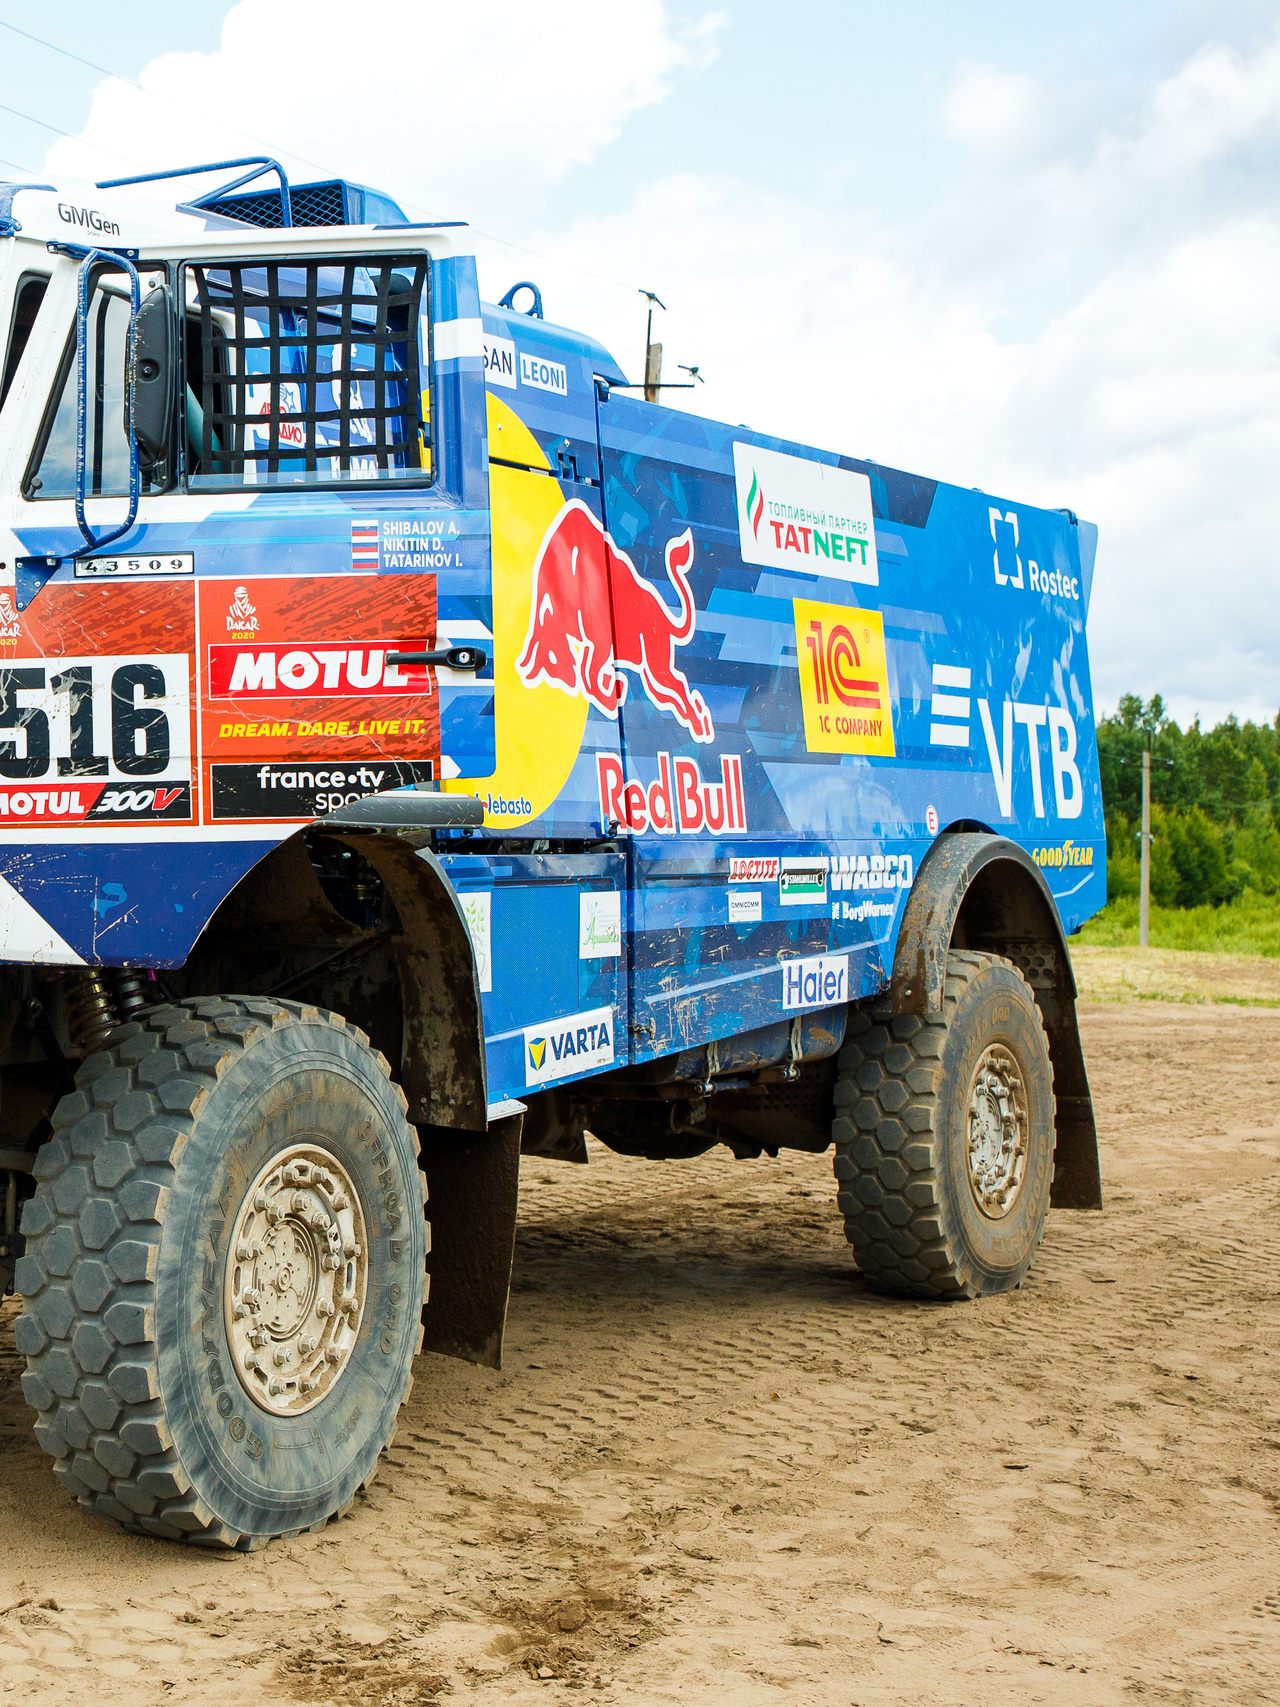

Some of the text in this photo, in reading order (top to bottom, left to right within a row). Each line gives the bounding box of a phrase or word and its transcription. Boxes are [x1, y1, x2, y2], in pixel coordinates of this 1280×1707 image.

[58, 203, 120, 236] GMGen
[522, 359, 564, 389] LEONI
[383, 521, 460, 535] SHIBALOV A.
[768, 501, 867, 535] ТОПЛИВНЫЙ ПАРТНЕР
[383, 538, 444, 552] NIKITIN D.
[770, 520, 868, 565] TATNEFT
[383, 554, 463, 568] TATARINOV I.
[1028, 559, 1080, 600] Rostec
[226, 616, 260, 631] DAKAR
[231, 632, 255, 640] 2020
[228, 649, 410, 690] MOTUL
[219, 719, 426, 738] DREAM. DARE. LIVE IT.
[819, 715, 882, 737] 1C COMPANY
[977, 698, 1083, 819] VTB
[96, 788, 184, 812] 300V
[596, 751, 747, 836] Red Bull
[928, 811, 936, 830] E
[729, 859, 778, 880] LOCTITE
[831, 854, 913, 891] WABCO
[842, 900, 895, 922] BorgWarner
[787, 960, 843, 1005] Haier
[550, 1022, 610, 1061] VARTA
